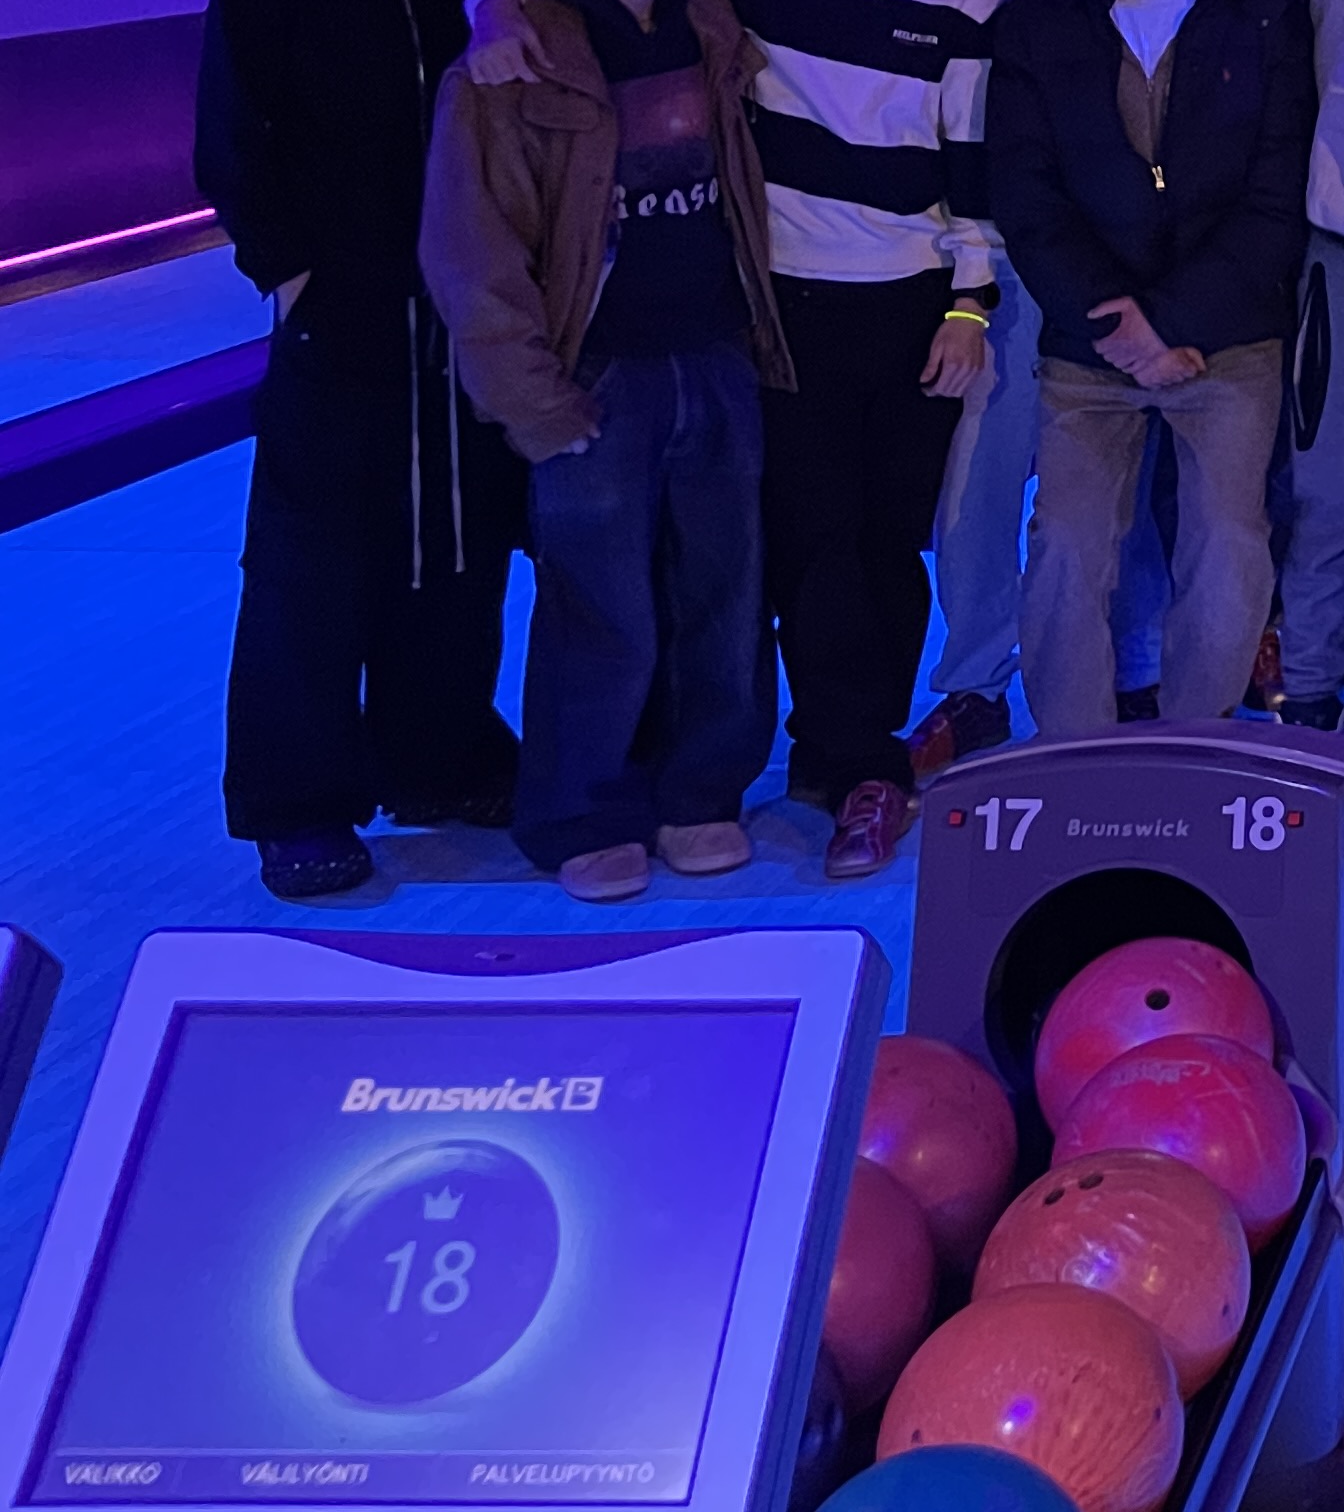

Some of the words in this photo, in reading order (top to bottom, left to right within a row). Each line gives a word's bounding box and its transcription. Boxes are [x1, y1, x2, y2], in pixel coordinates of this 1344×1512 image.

[975, 797, 1043, 851] 17
[1066, 818, 1191, 838] Brunswick
[1222, 796, 1286, 851] 18
[341, 1077, 561, 1112] Brunswick
[384, 1238, 477, 1315] 18
